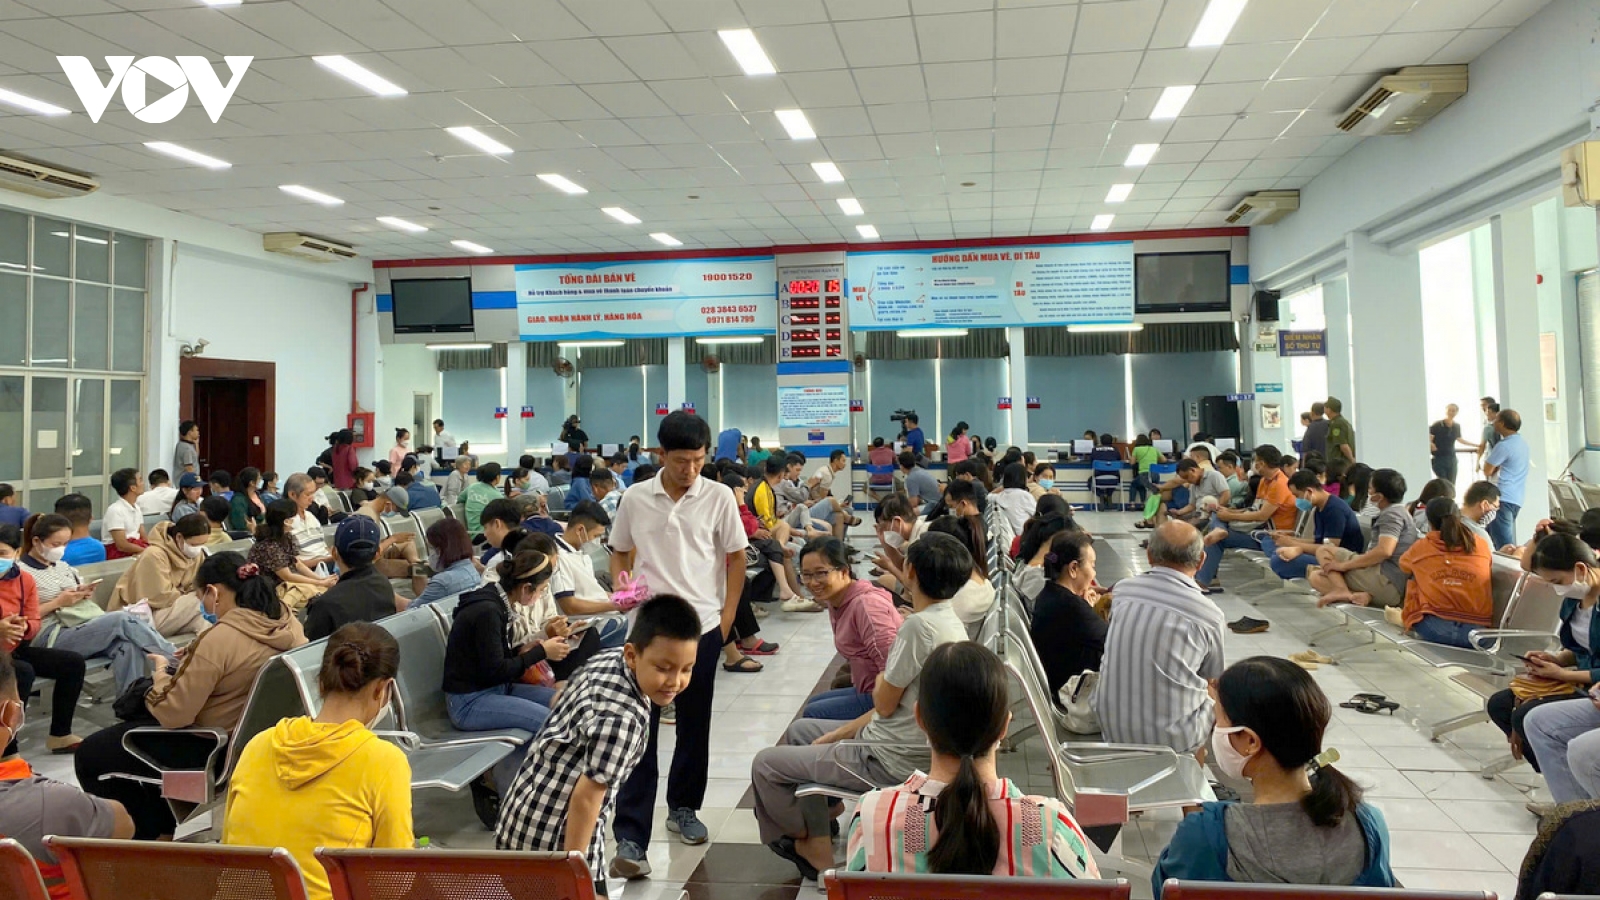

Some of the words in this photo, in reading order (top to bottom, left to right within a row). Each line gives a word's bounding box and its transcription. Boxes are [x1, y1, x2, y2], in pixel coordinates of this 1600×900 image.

[962, 252, 978, 262] DẪN
[980, 253, 998, 262] MUA
[1024, 251, 1040, 260] TÀU
[559, 274, 584, 284] TỔNG
[586, 274, 602, 284] ĐÀI
[604, 274, 622, 283] BÁN
[624, 272, 636, 282] VÉ
[702, 273, 752, 281] 19001520
[781, 284, 789, 292] A
[828, 280, 840, 292] 15
[782, 300, 789, 308] B
[701, 306, 715, 314] 028
[548, 314, 569, 324] NHẬN
[604, 312, 625, 321] HÀNG
[781, 316, 790, 324] C
[782, 332, 790, 341] D
[782, 348, 790, 356] E
